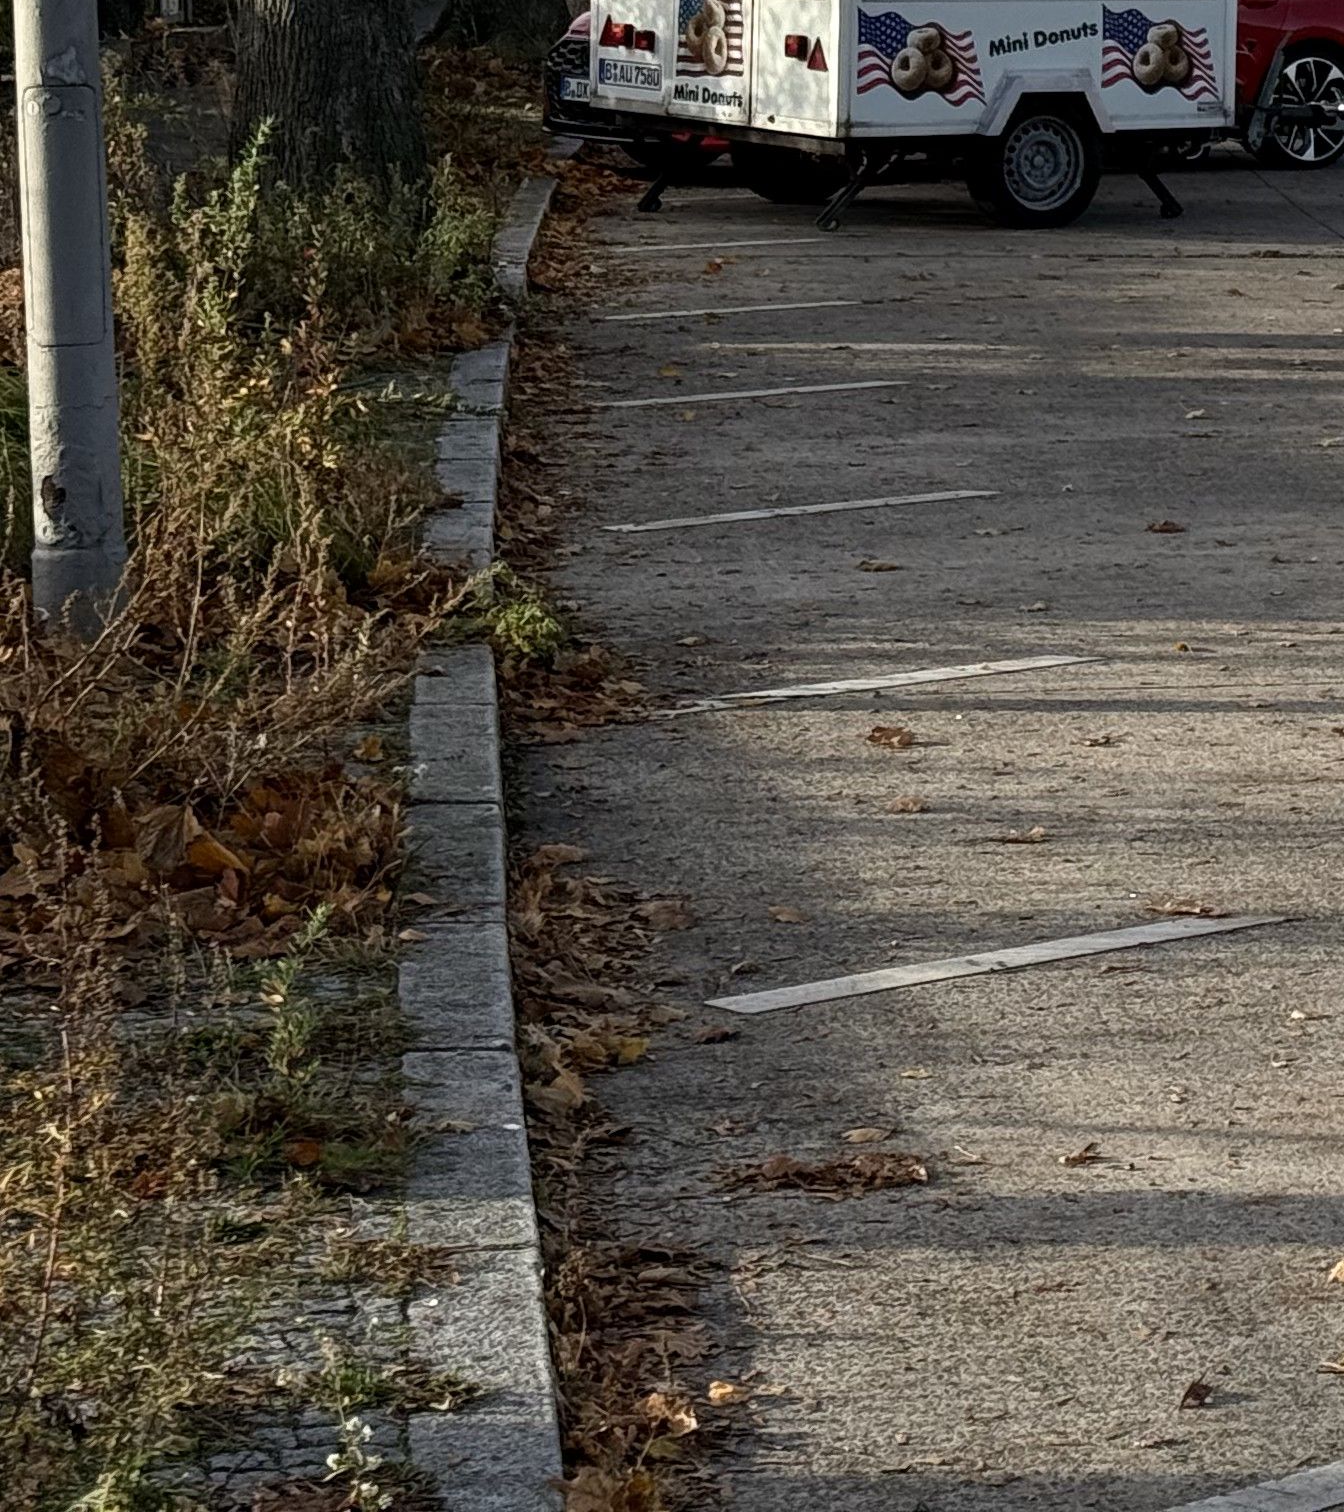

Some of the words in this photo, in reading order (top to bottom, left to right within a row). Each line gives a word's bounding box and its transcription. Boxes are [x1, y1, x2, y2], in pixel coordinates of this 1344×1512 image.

[989, 32, 1029, 57] Mini
[1034, 22, 1099, 48] Donuts
[673, 83, 699, 102] Mini
[702, 87, 743, 107] Donuts
